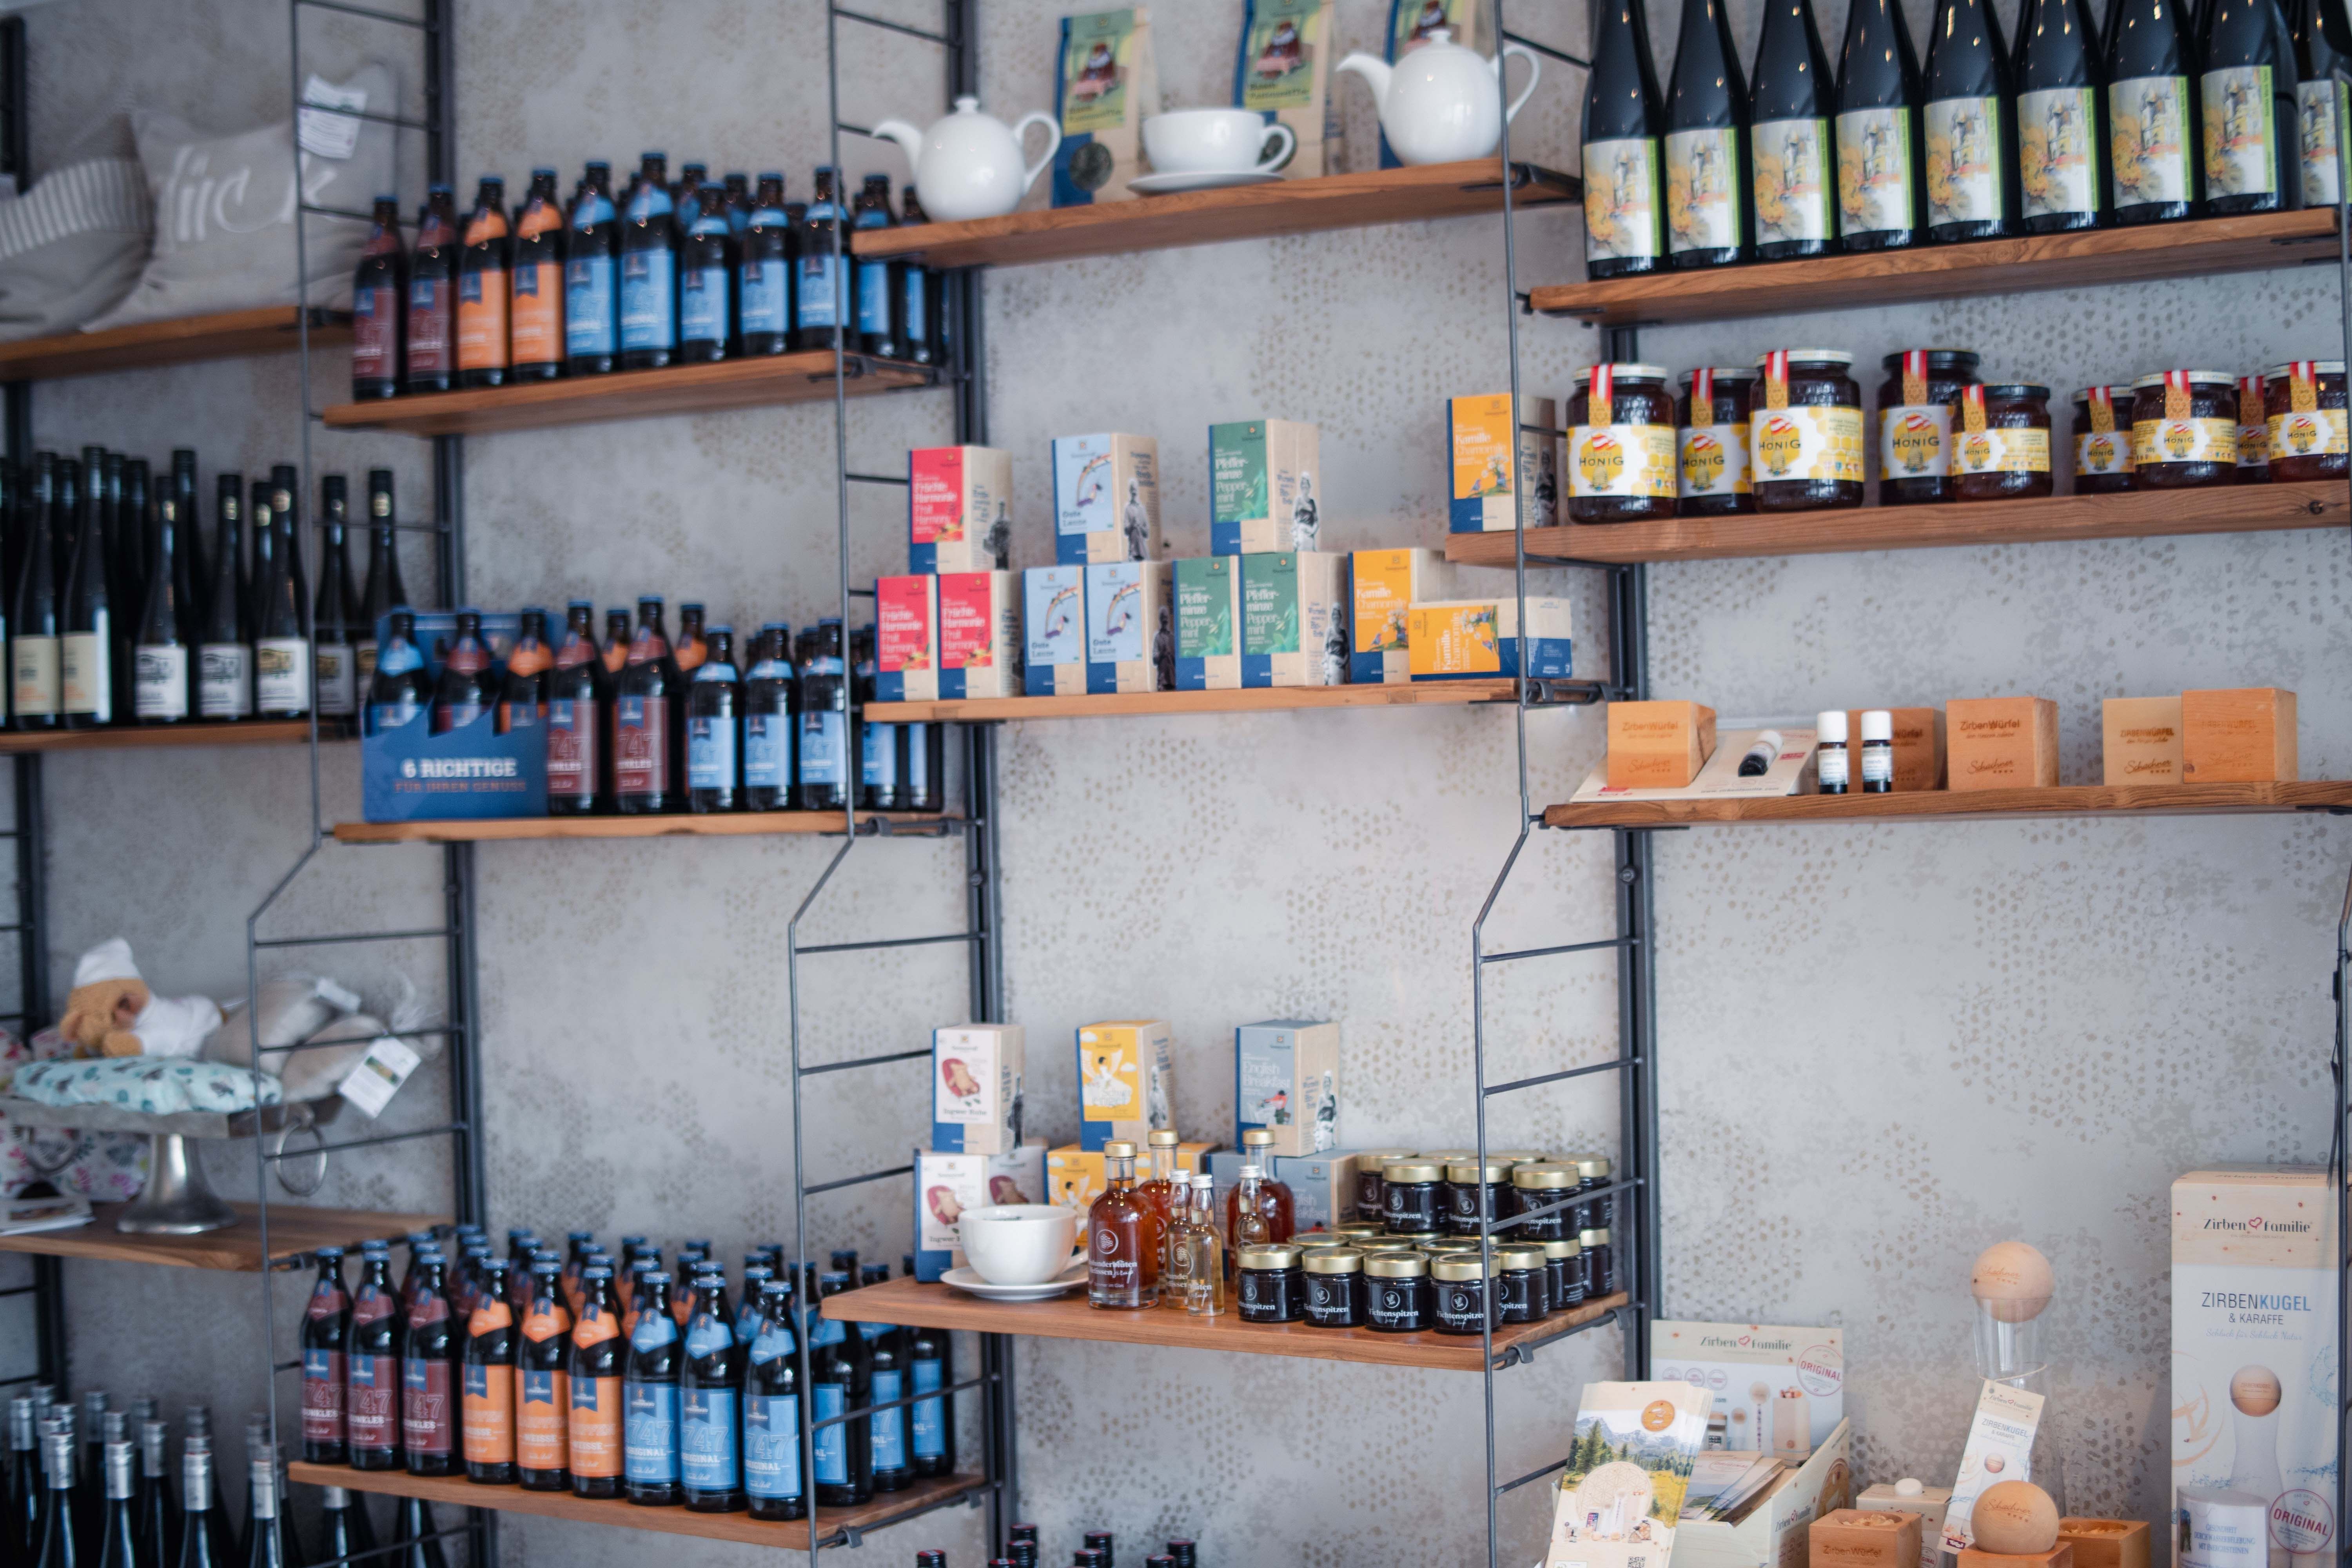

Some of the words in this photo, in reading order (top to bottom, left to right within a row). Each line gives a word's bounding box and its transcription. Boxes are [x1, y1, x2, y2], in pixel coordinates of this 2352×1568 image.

[1456, 433, 1491, 445] Kamille
[2287, 431, 2317, 439] HONIG
[1759, 439, 1800, 451] HONIG
[1893, 436, 1939, 449] HONIG
[1456, 443, 1507, 455] Chamomile
[1215, 457, 1248, 470] Pfeffer-
[1580, 457, 1624, 466] HONIG
[1682, 456, 1724, 467] HONIG
[1216, 470, 1243, 480] minze
[1180, 593, 1212, 604] Pfeffer-
[1246, 589, 1279, 601] Pfeffer-
[1356, 587, 1391, 599] Kamille
[1247, 602, 1273, 612] minze
[1357, 598, 1406, 609] Chamomile
[1180, 605, 1207, 615] minze
[1181, 617, 1214, 628] Pepper-
[1247, 613, 1279, 625] Pepper-
[1181, 629, 1199, 638] mint
[1247, 626, 1265, 635] mint
[1451, 612, 1461, 670] Chamomile
[1441, 630, 1451, 670] Kamille
[1622, 721, 1678, 731] ZirbenWürfel
[1960, 719, 2020, 730] ZirbenWürfel
[403, 759, 416, 778] 6
[420, 758, 517, 777] RICHTIGE
[1243, 1062, 1280, 1075] English
[1243, 1075, 1290, 1089] Breakfast
[1294, 1209, 1327, 1220] akfast
[2203, 1218, 2246, 1230] Zirben
[2201, 1292, 2311, 1311] ZIRBENKUGEL
[1368, 1308, 1419, 1319] Fichtenspitzen
[2229, 1313, 2235, 1323] &
[2239, 1314, 2284, 1325] KARAFFE
[1700, 1336, 1737, 1348] Zirben
[1800, 1361, 1842, 1382] ORIGINAL
[348, 1388, 392, 1414] 747
[626, 1419, 674, 1446] 747
[1982, 1418, 2027, 1437] ZIRBENKUGEL
[523, 1434, 557, 1443] WEISSE
[681, 1425, 728, 1452] 747
[626, 1447, 666, 1457] ORIGINAL
[746, 1432, 789, 1460] 747
[681, 1452, 720, 1463] ORIGINAL
[2274, 1508, 2328, 1536] ORIGINAL
[2205, 1524, 2237, 1534] GESUNDHEIT
